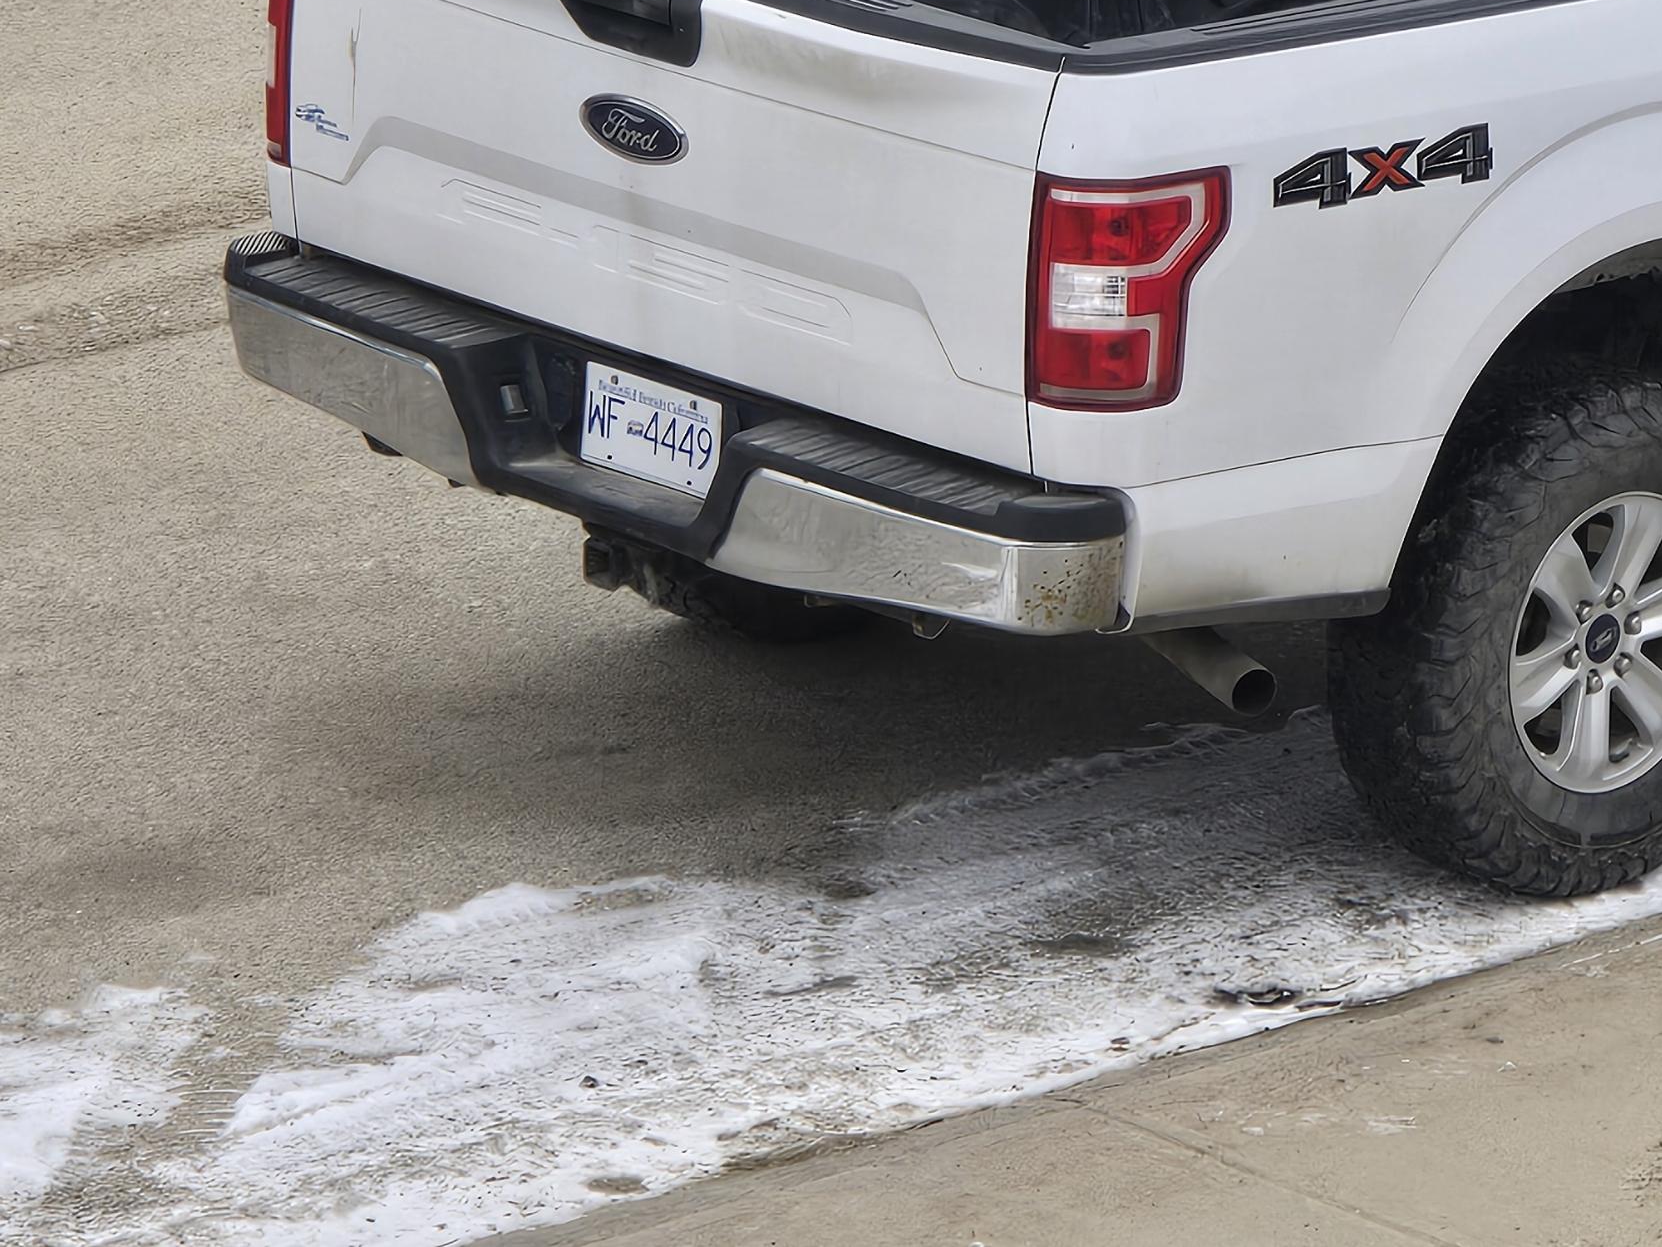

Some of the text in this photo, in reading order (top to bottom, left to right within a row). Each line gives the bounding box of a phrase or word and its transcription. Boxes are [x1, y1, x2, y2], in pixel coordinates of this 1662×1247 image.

[602, 108, 660, 152] Ford
[587, 390, 626, 440] WF
[643, 410, 713, 471] 4449
